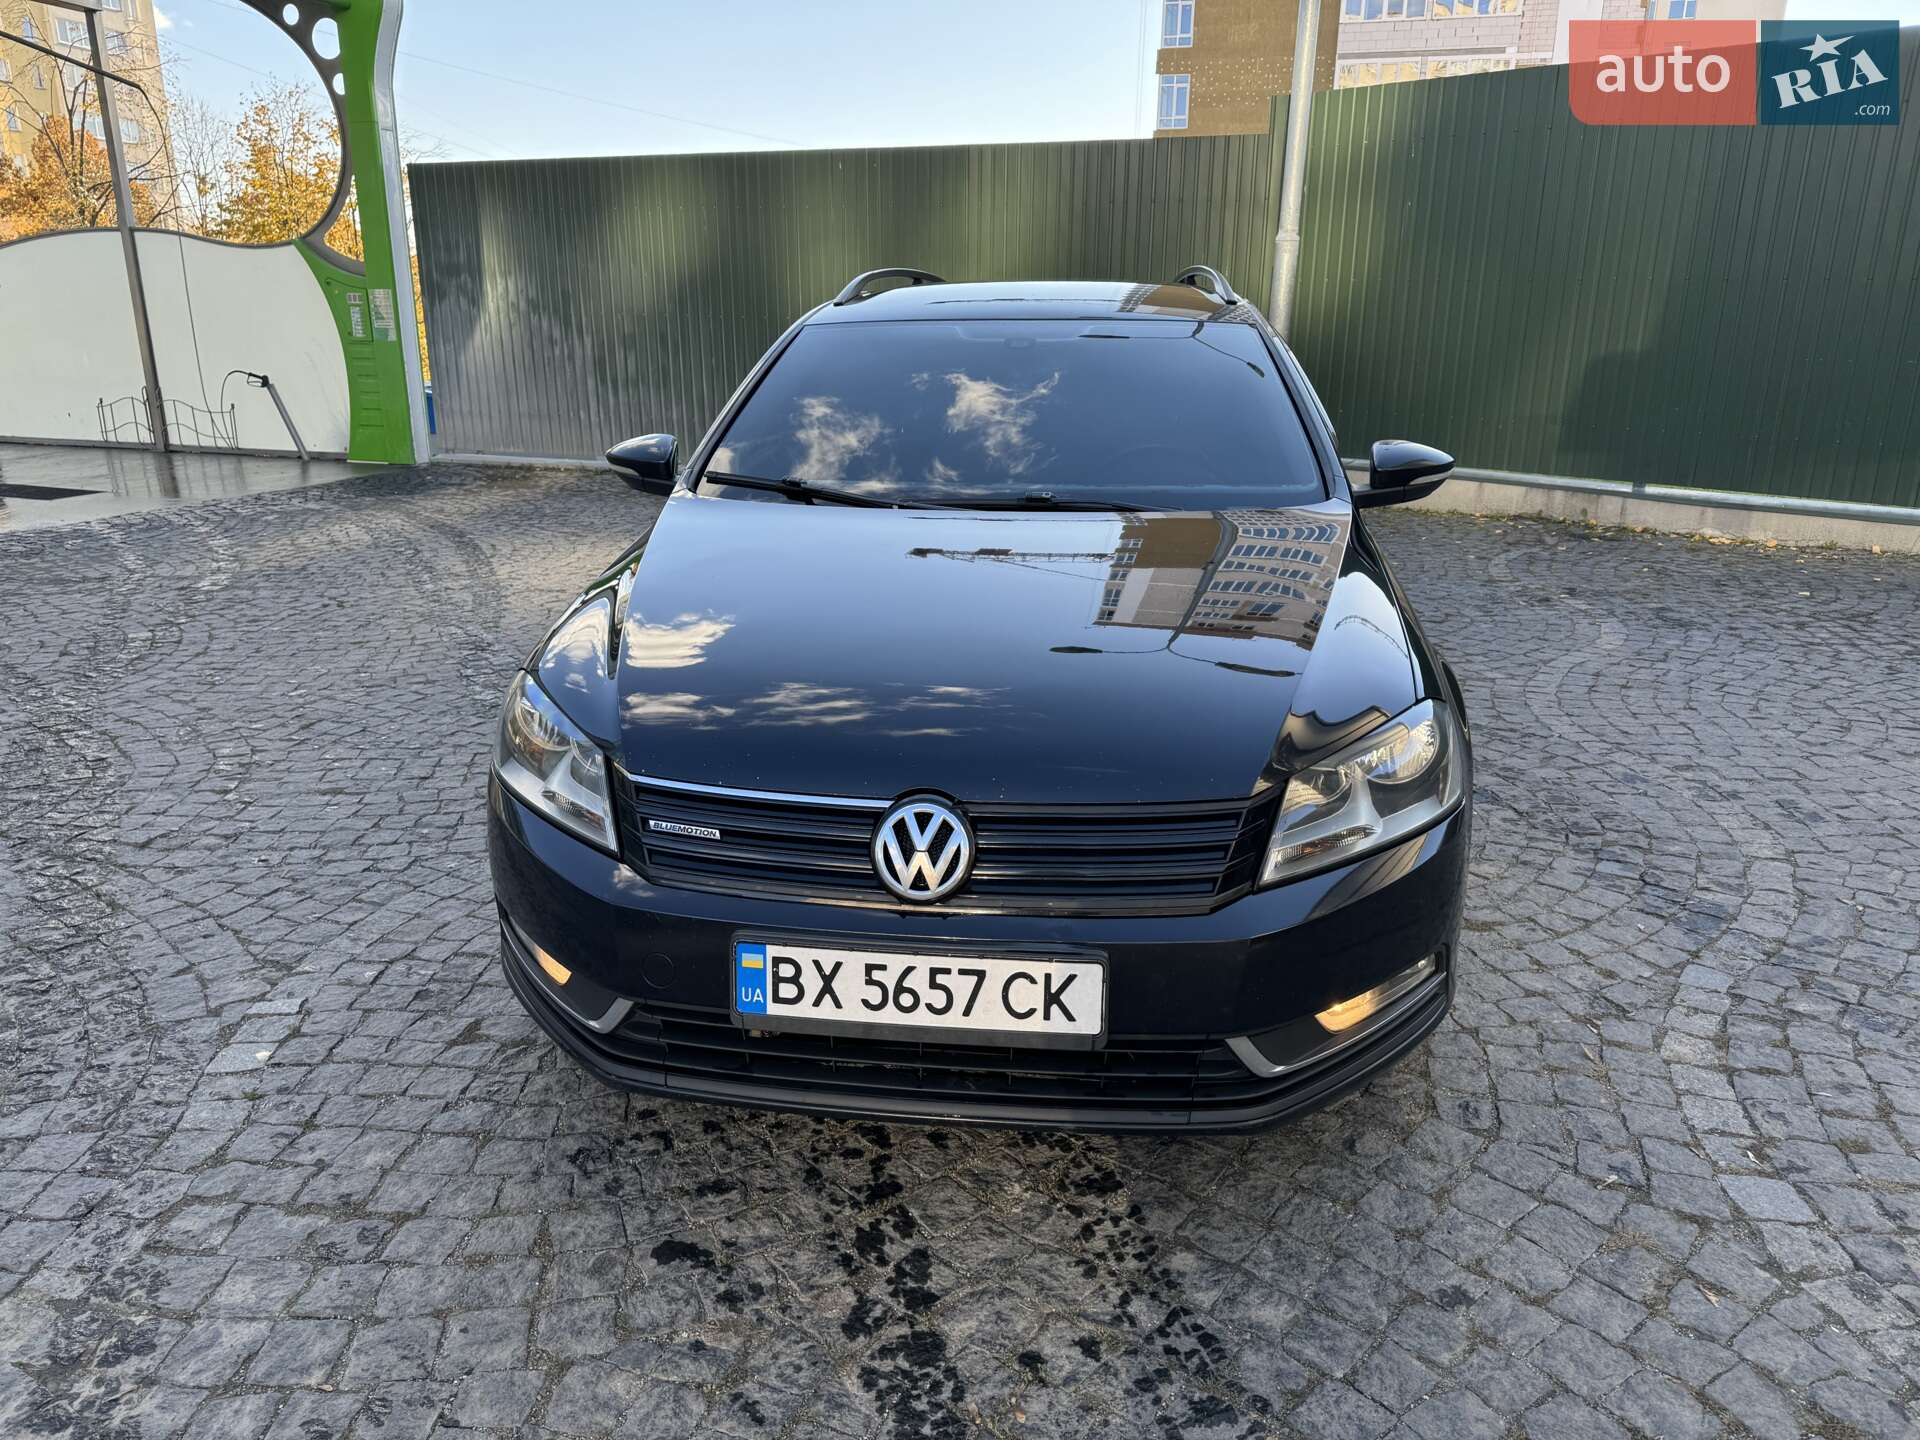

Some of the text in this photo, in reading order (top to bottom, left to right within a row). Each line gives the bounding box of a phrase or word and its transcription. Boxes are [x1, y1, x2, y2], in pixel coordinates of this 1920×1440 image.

[652, 820, 718, 838] BLUEMOTION
[880, 804, 965, 894] VW
[741, 987, 763, 1003] UA
[771, 956, 1077, 1022] BX 5657 CK
